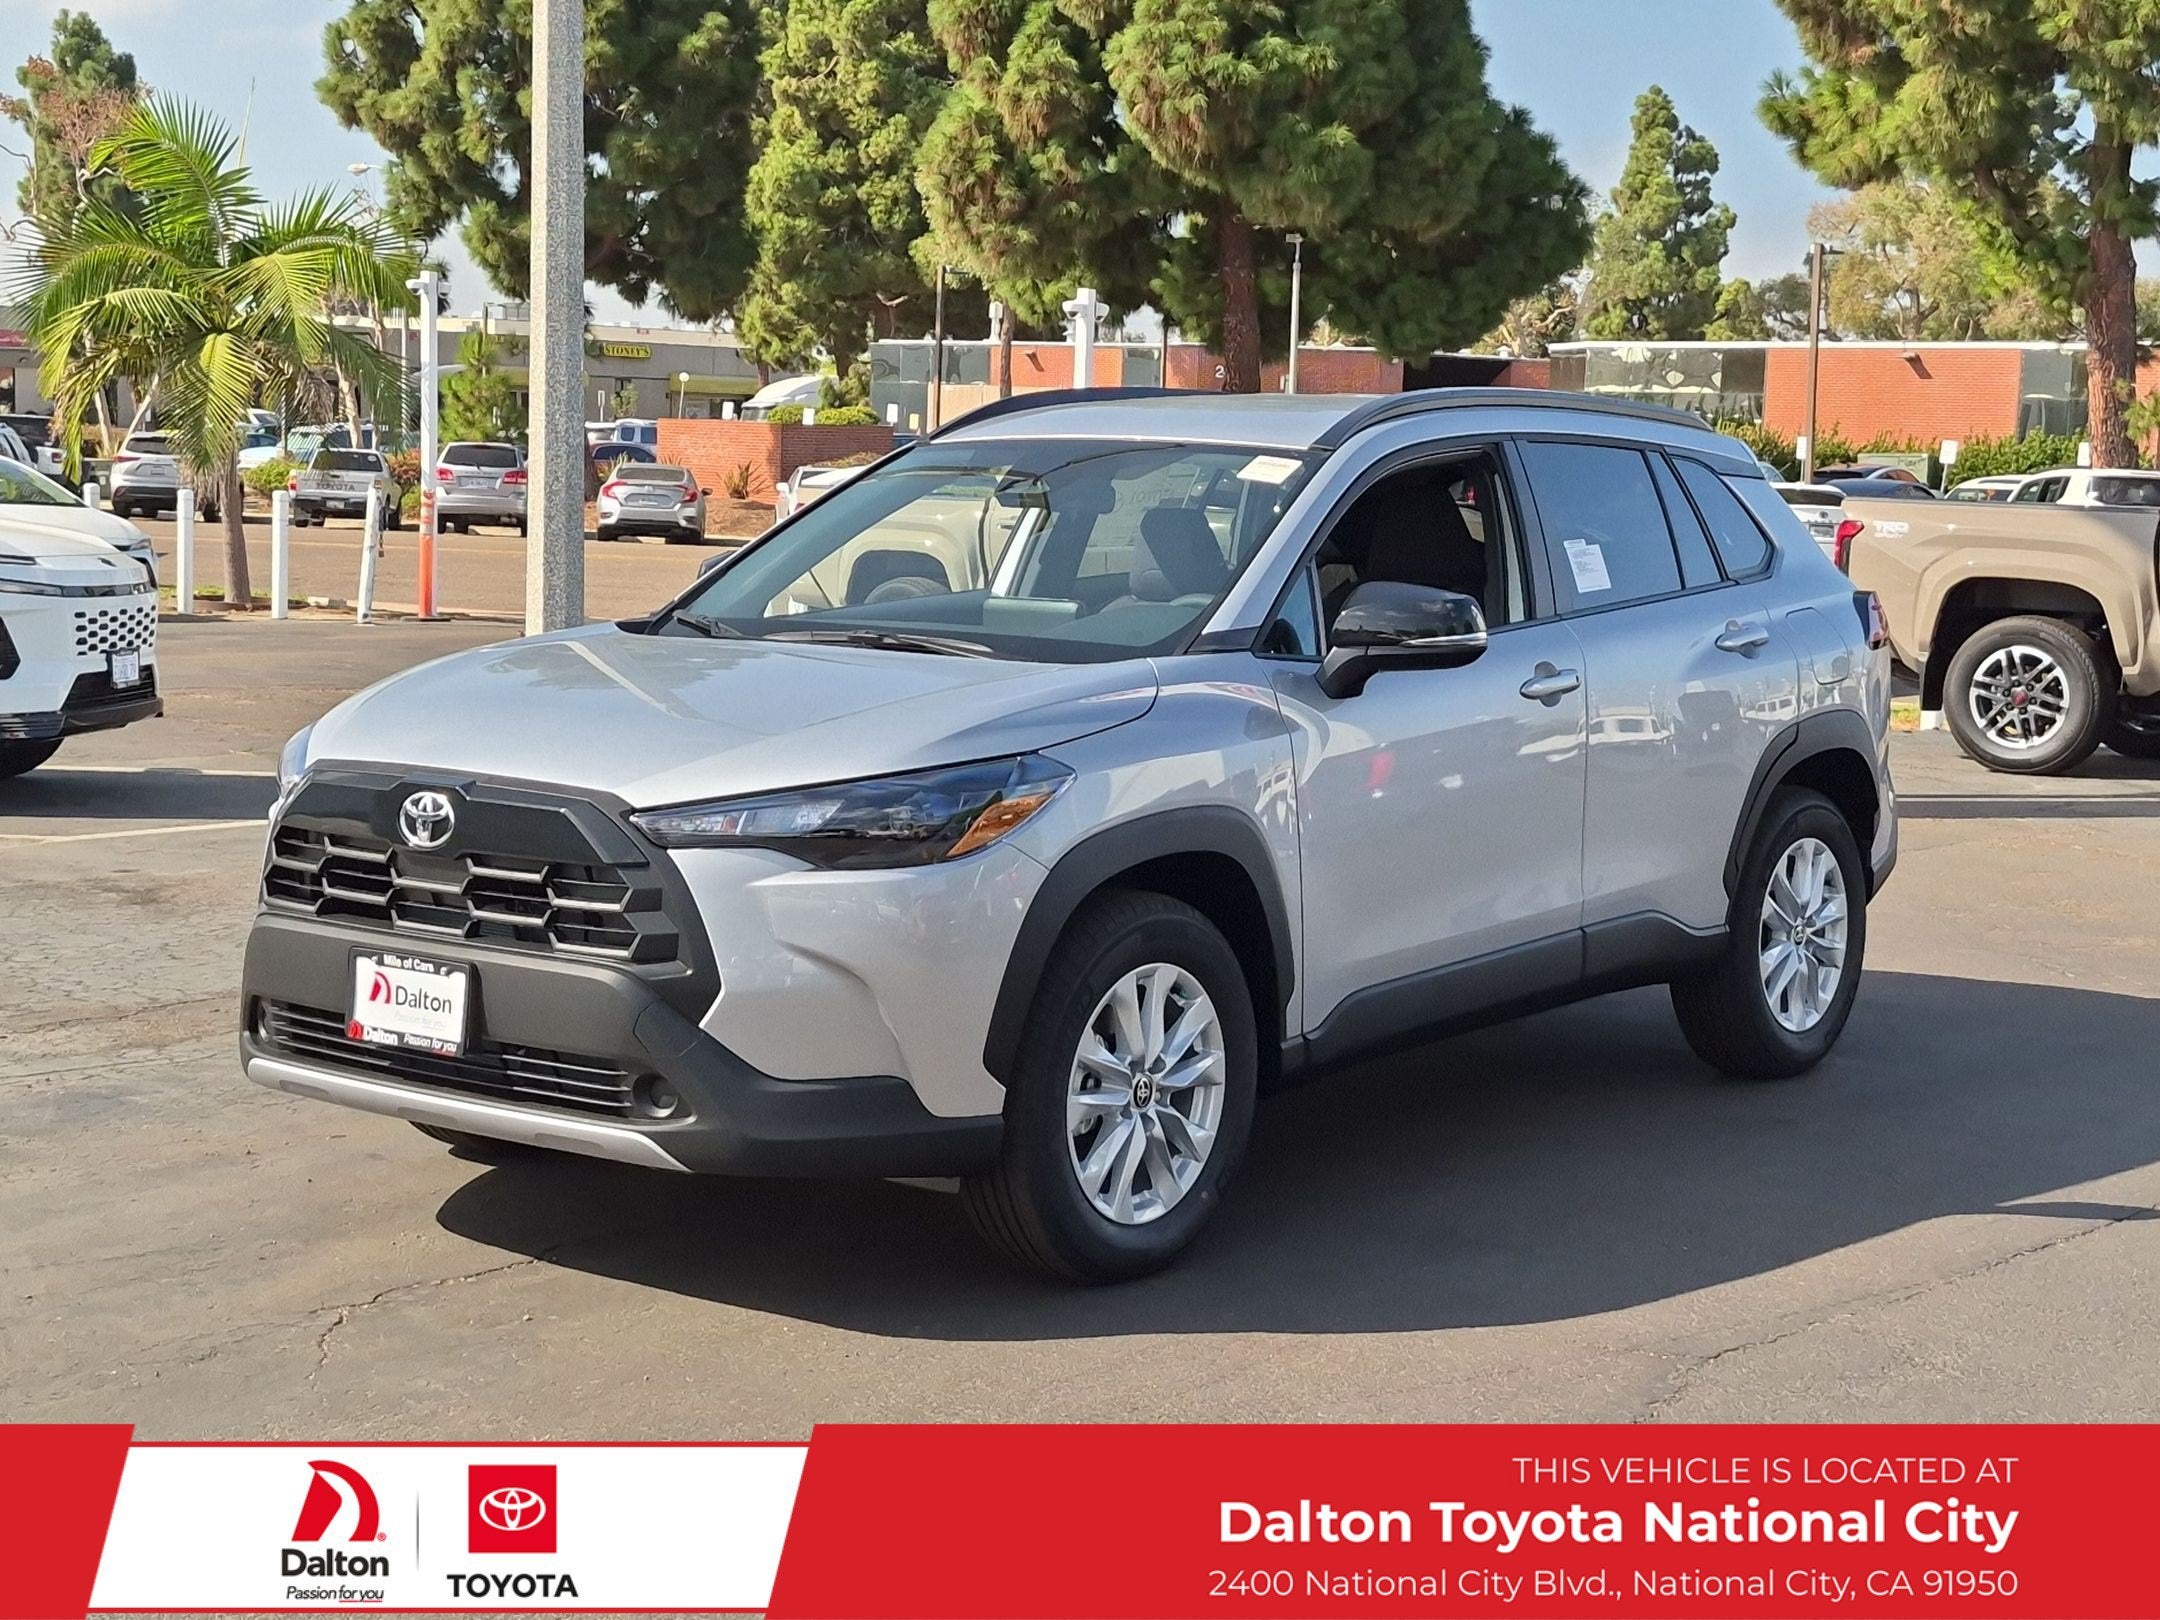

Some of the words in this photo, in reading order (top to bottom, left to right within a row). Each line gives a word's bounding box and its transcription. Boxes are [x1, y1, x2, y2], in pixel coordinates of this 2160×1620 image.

[315, 482, 356, 491] TOYOTA
[1873, 520, 1909, 533] TRD
[383, 954, 402, 968] Mile
[402, 957, 413, 969] of
[413, 959, 435, 973] Cars
[395, 985, 452, 1014] Dalton
[363, 1026, 399, 1046] Dalton
[403, 1033, 431, 1048] Passion
[431, 1038, 444, 1049] for
[442, 1041, 458, 1053] you
